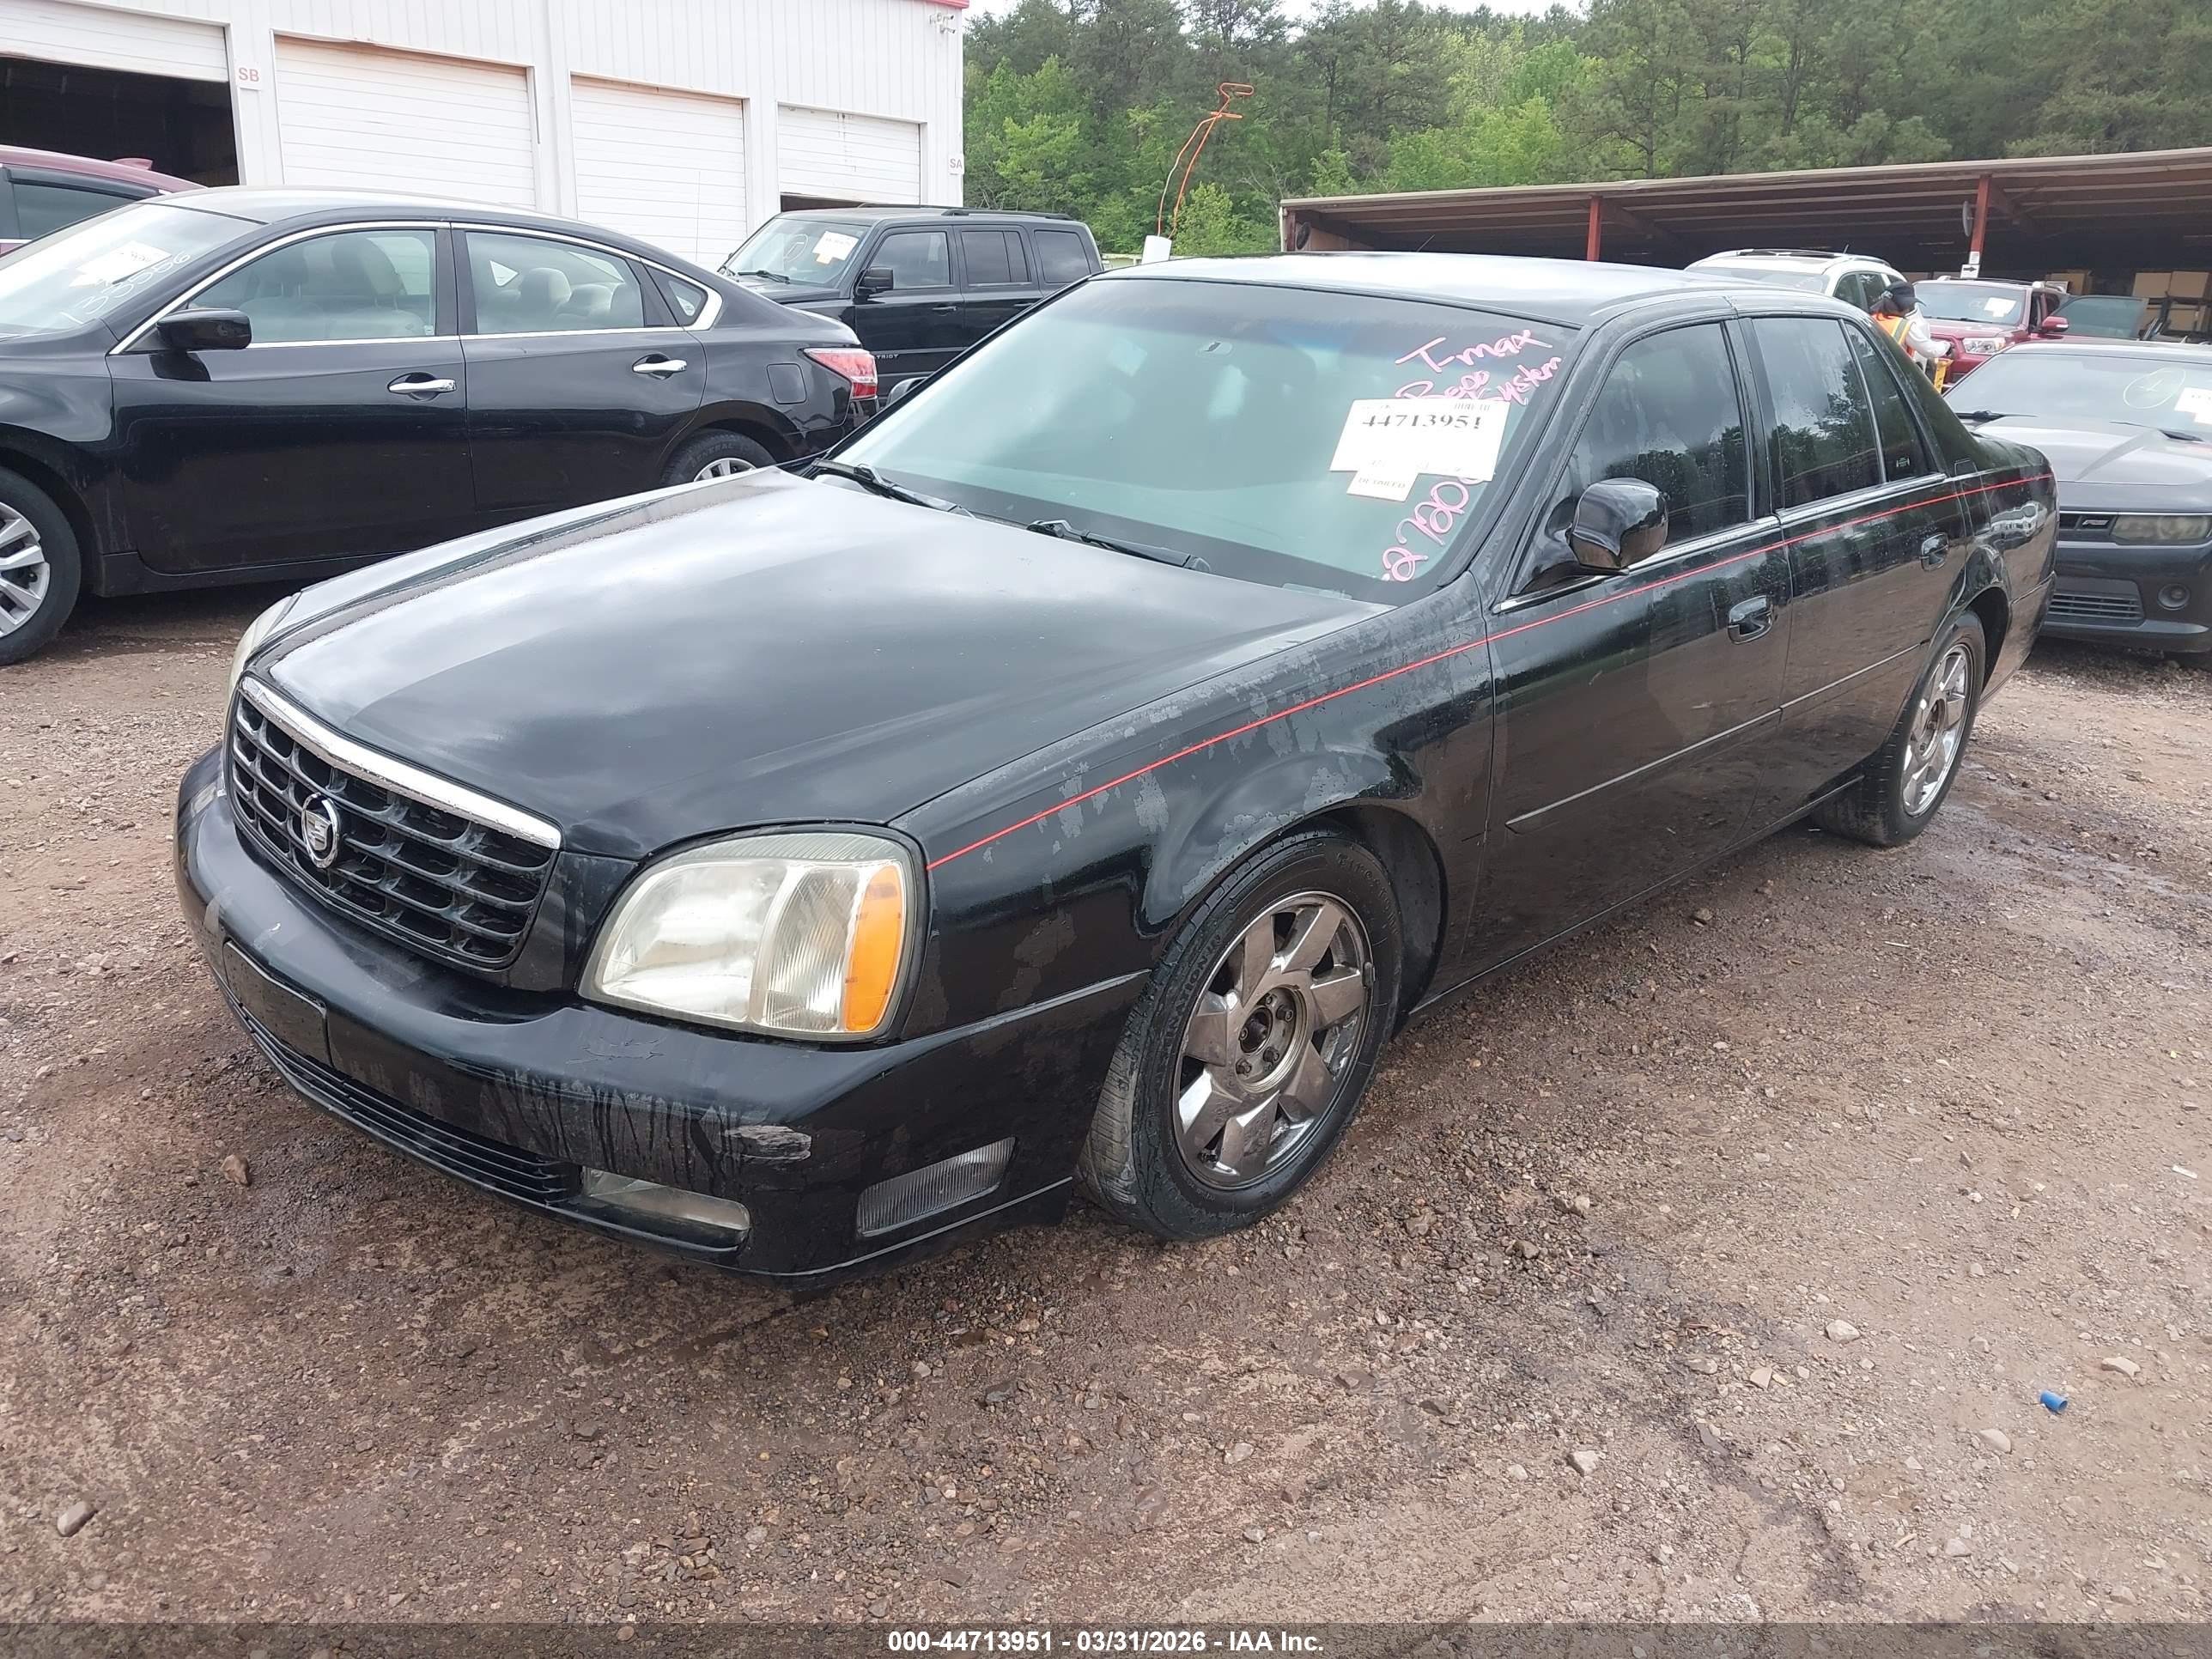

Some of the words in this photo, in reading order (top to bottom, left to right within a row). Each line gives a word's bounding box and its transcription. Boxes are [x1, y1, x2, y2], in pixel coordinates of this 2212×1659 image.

[239, 67, 259, 82] SB
[950, 158, 963, 168] SA
[1362, 414, 1483, 429] 44713951
